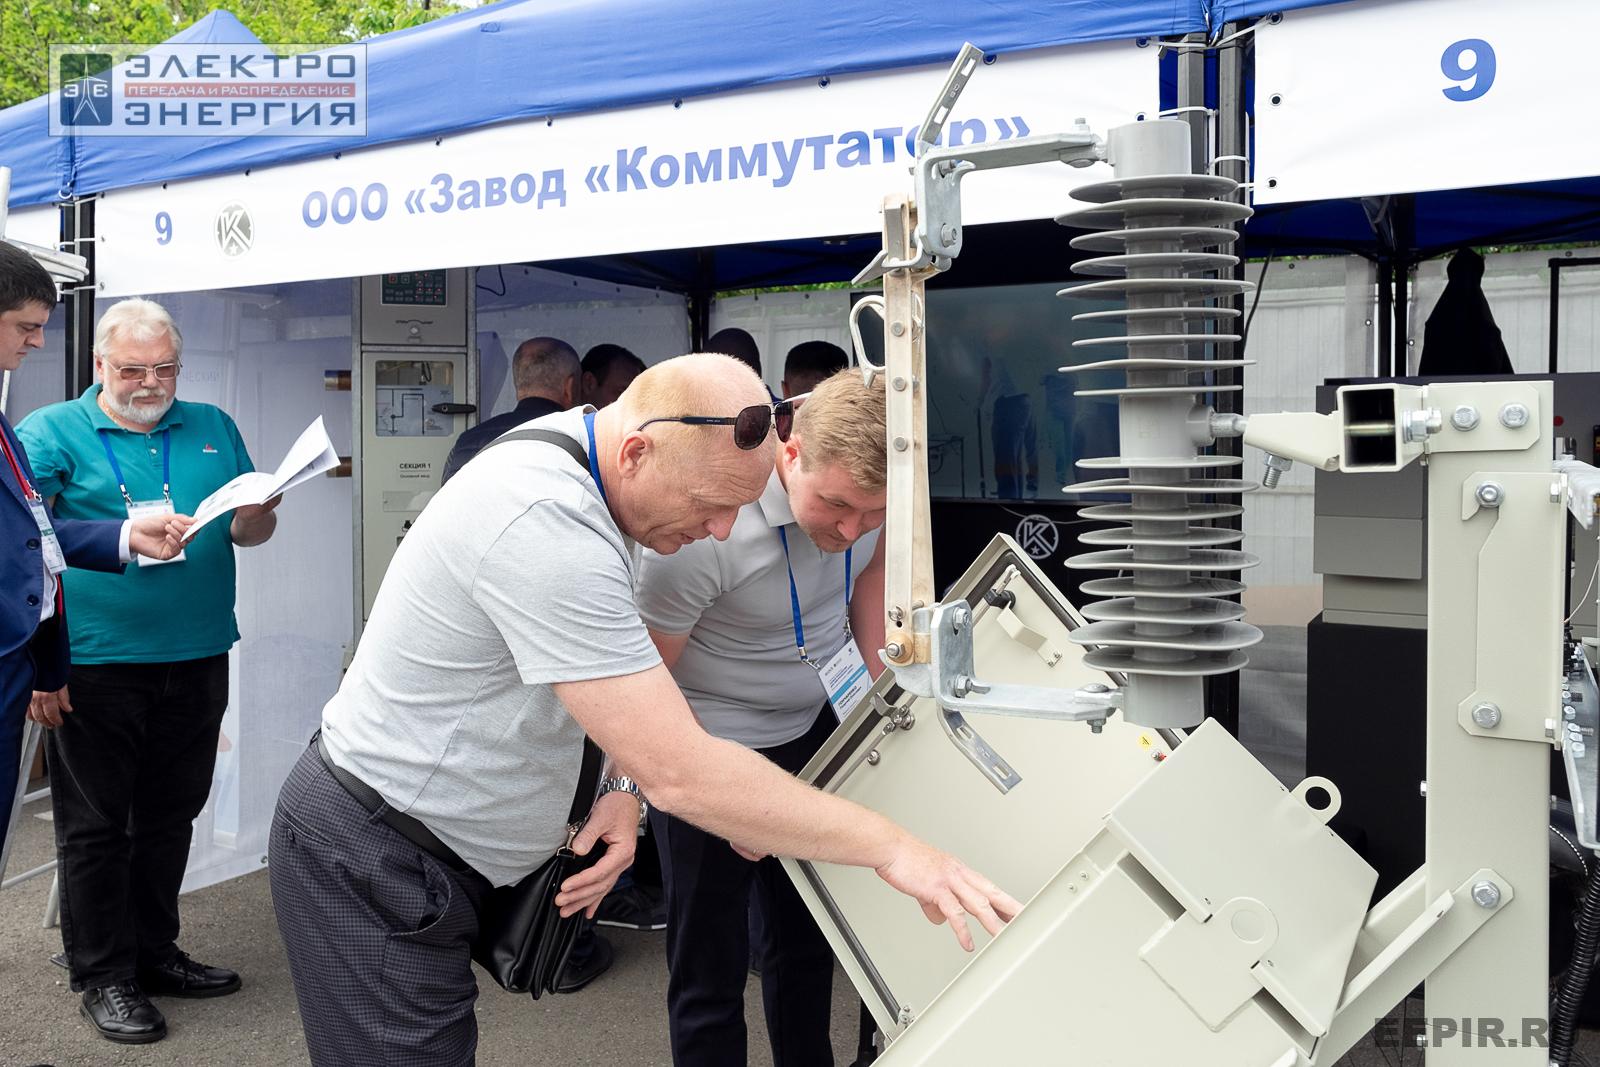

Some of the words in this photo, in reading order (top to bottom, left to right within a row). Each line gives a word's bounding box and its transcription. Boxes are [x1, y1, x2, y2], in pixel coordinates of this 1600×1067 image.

[1440, 38, 1497, 102] 9
[155, 211, 173, 246] 9
[302, 182, 389, 229] ООО
[404, 168, 567, 215] «Завод
